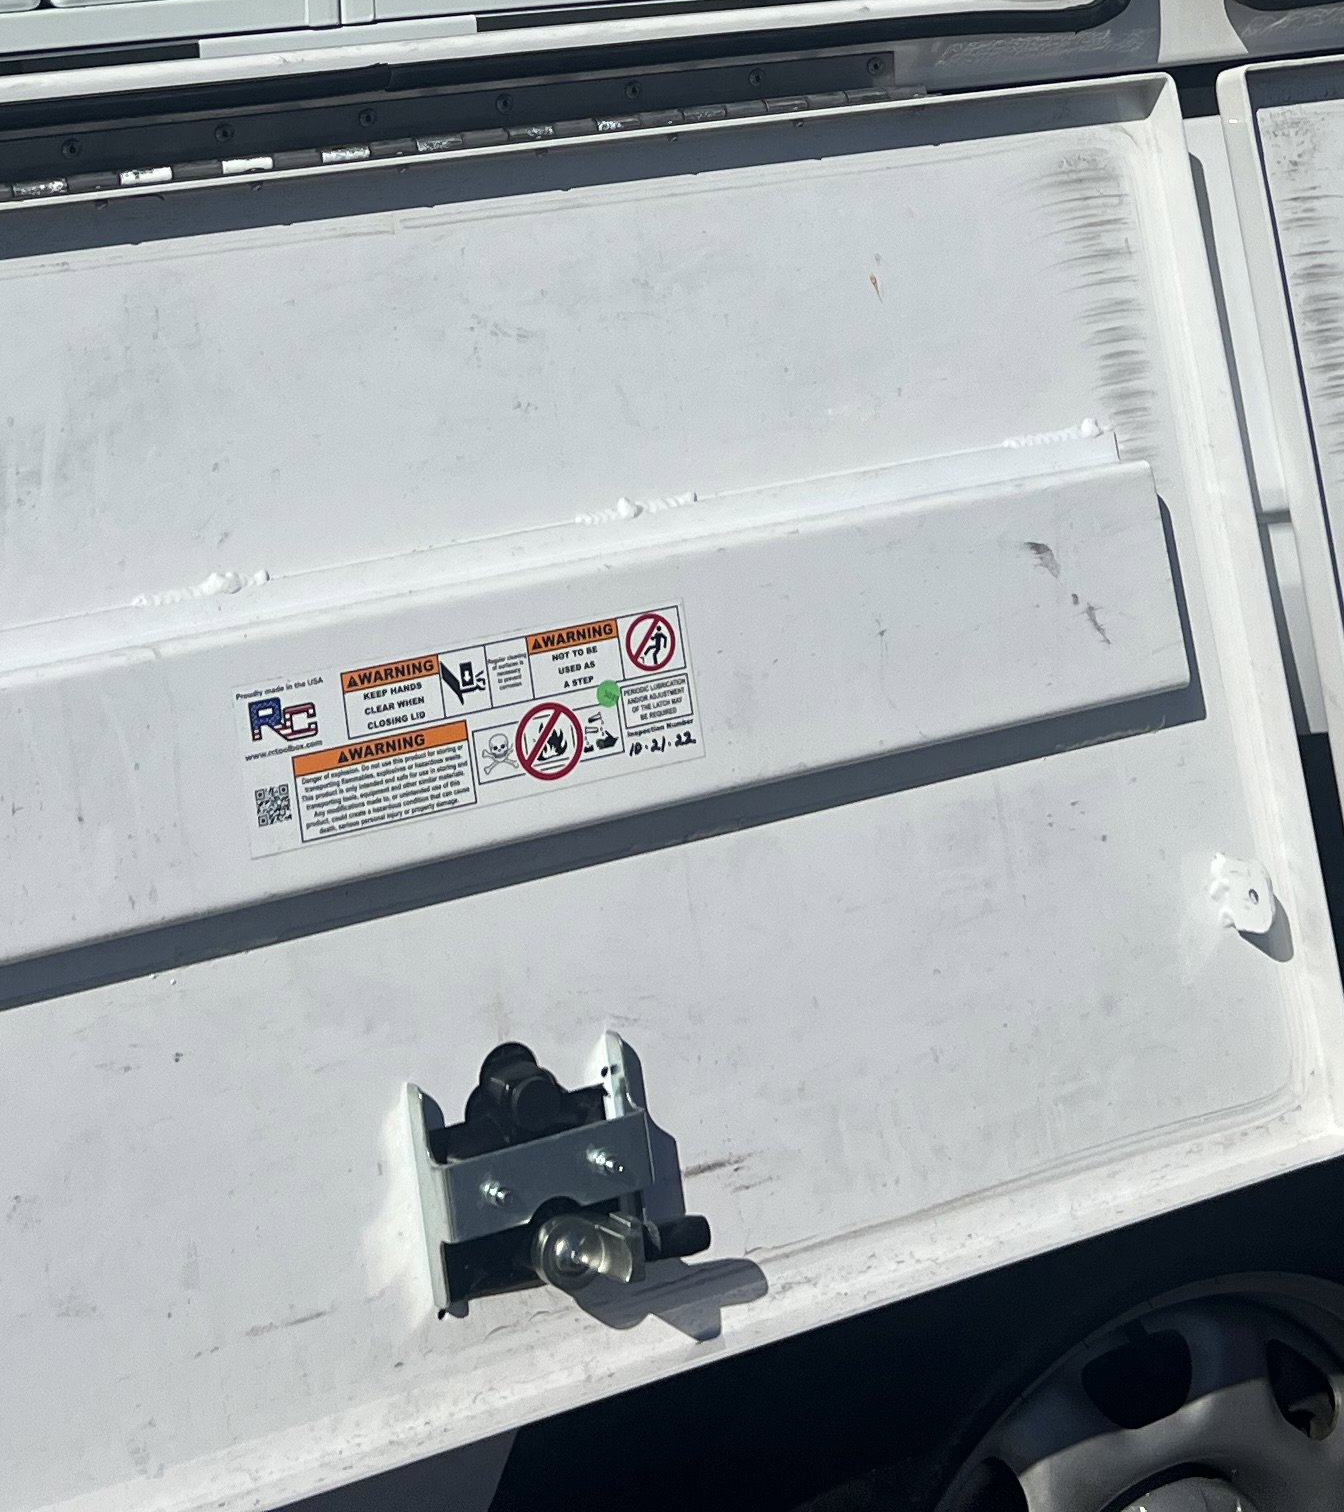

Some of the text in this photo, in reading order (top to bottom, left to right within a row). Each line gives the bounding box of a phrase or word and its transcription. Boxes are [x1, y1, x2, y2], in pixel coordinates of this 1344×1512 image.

[542, 623, 612, 647] WARNING
[551, 645, 597, 661] NOT TO BE
[358, 659, 433, 684] WARNING
[558, 660, 595, 674] USED AS
[307, 676, 323, 685] USA
[563, 675, 593, 688] A STEP
[363, 681, 421, 699] KEEP HANDS
[364, 696, 424, 715] CLEAR WHEN
[248, 697, 317, 741] RC
[367, 711, 425, 729] CLOSING LID
[348, 734, 424, 760] WARNING
